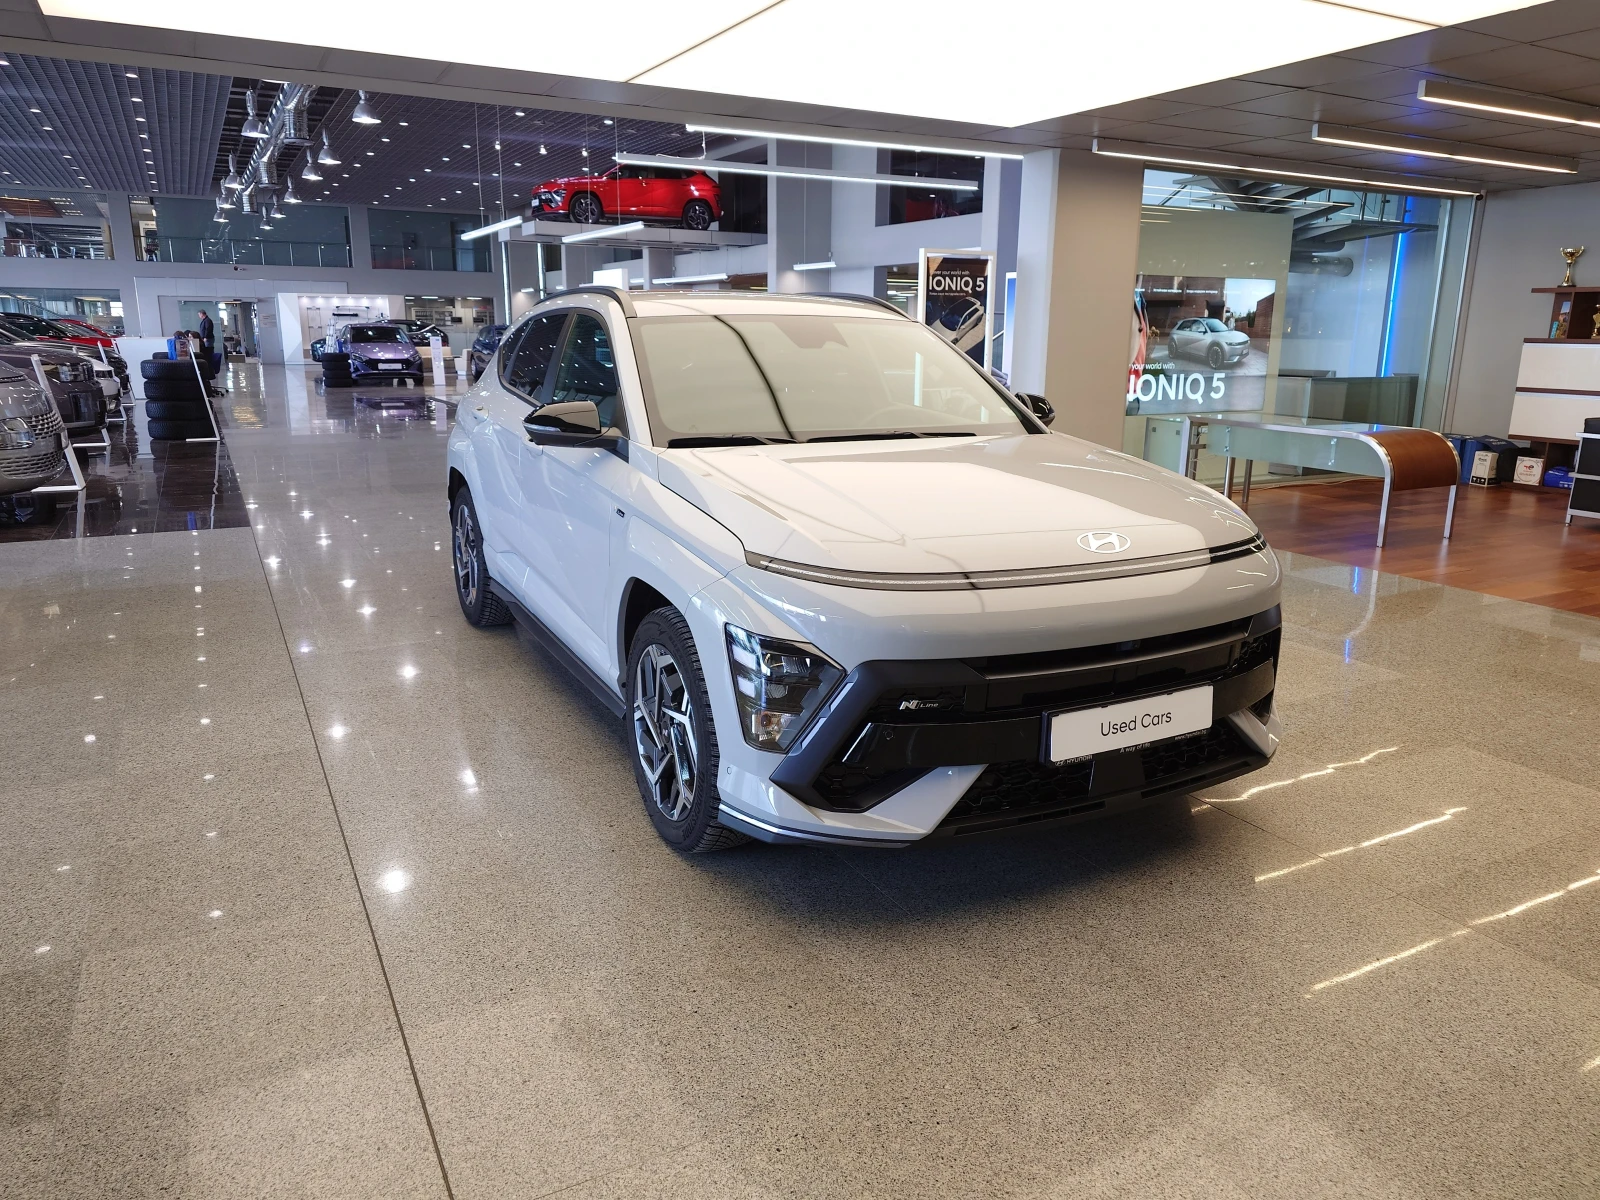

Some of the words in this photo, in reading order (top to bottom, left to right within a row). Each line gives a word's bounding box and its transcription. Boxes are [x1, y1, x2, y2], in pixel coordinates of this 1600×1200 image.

[929, 276, 973, 293] IONIQ
[975, 277, 985, 291] 5
[1131, 363, 1144, 371] your
[1145, 362, 1162, 370] world
[1162, 362, 1175, 370] with
[1128, 372, 1206, 404] IONIQ
[1210, 373, 1225, 399] 5
[1100, 715, 1137, 736] Used
[1141, 711, 1172, 728] Cars
[1125, 745, 1136, 753] way
[1066, 754, 1093, 765] HYUNDAI
